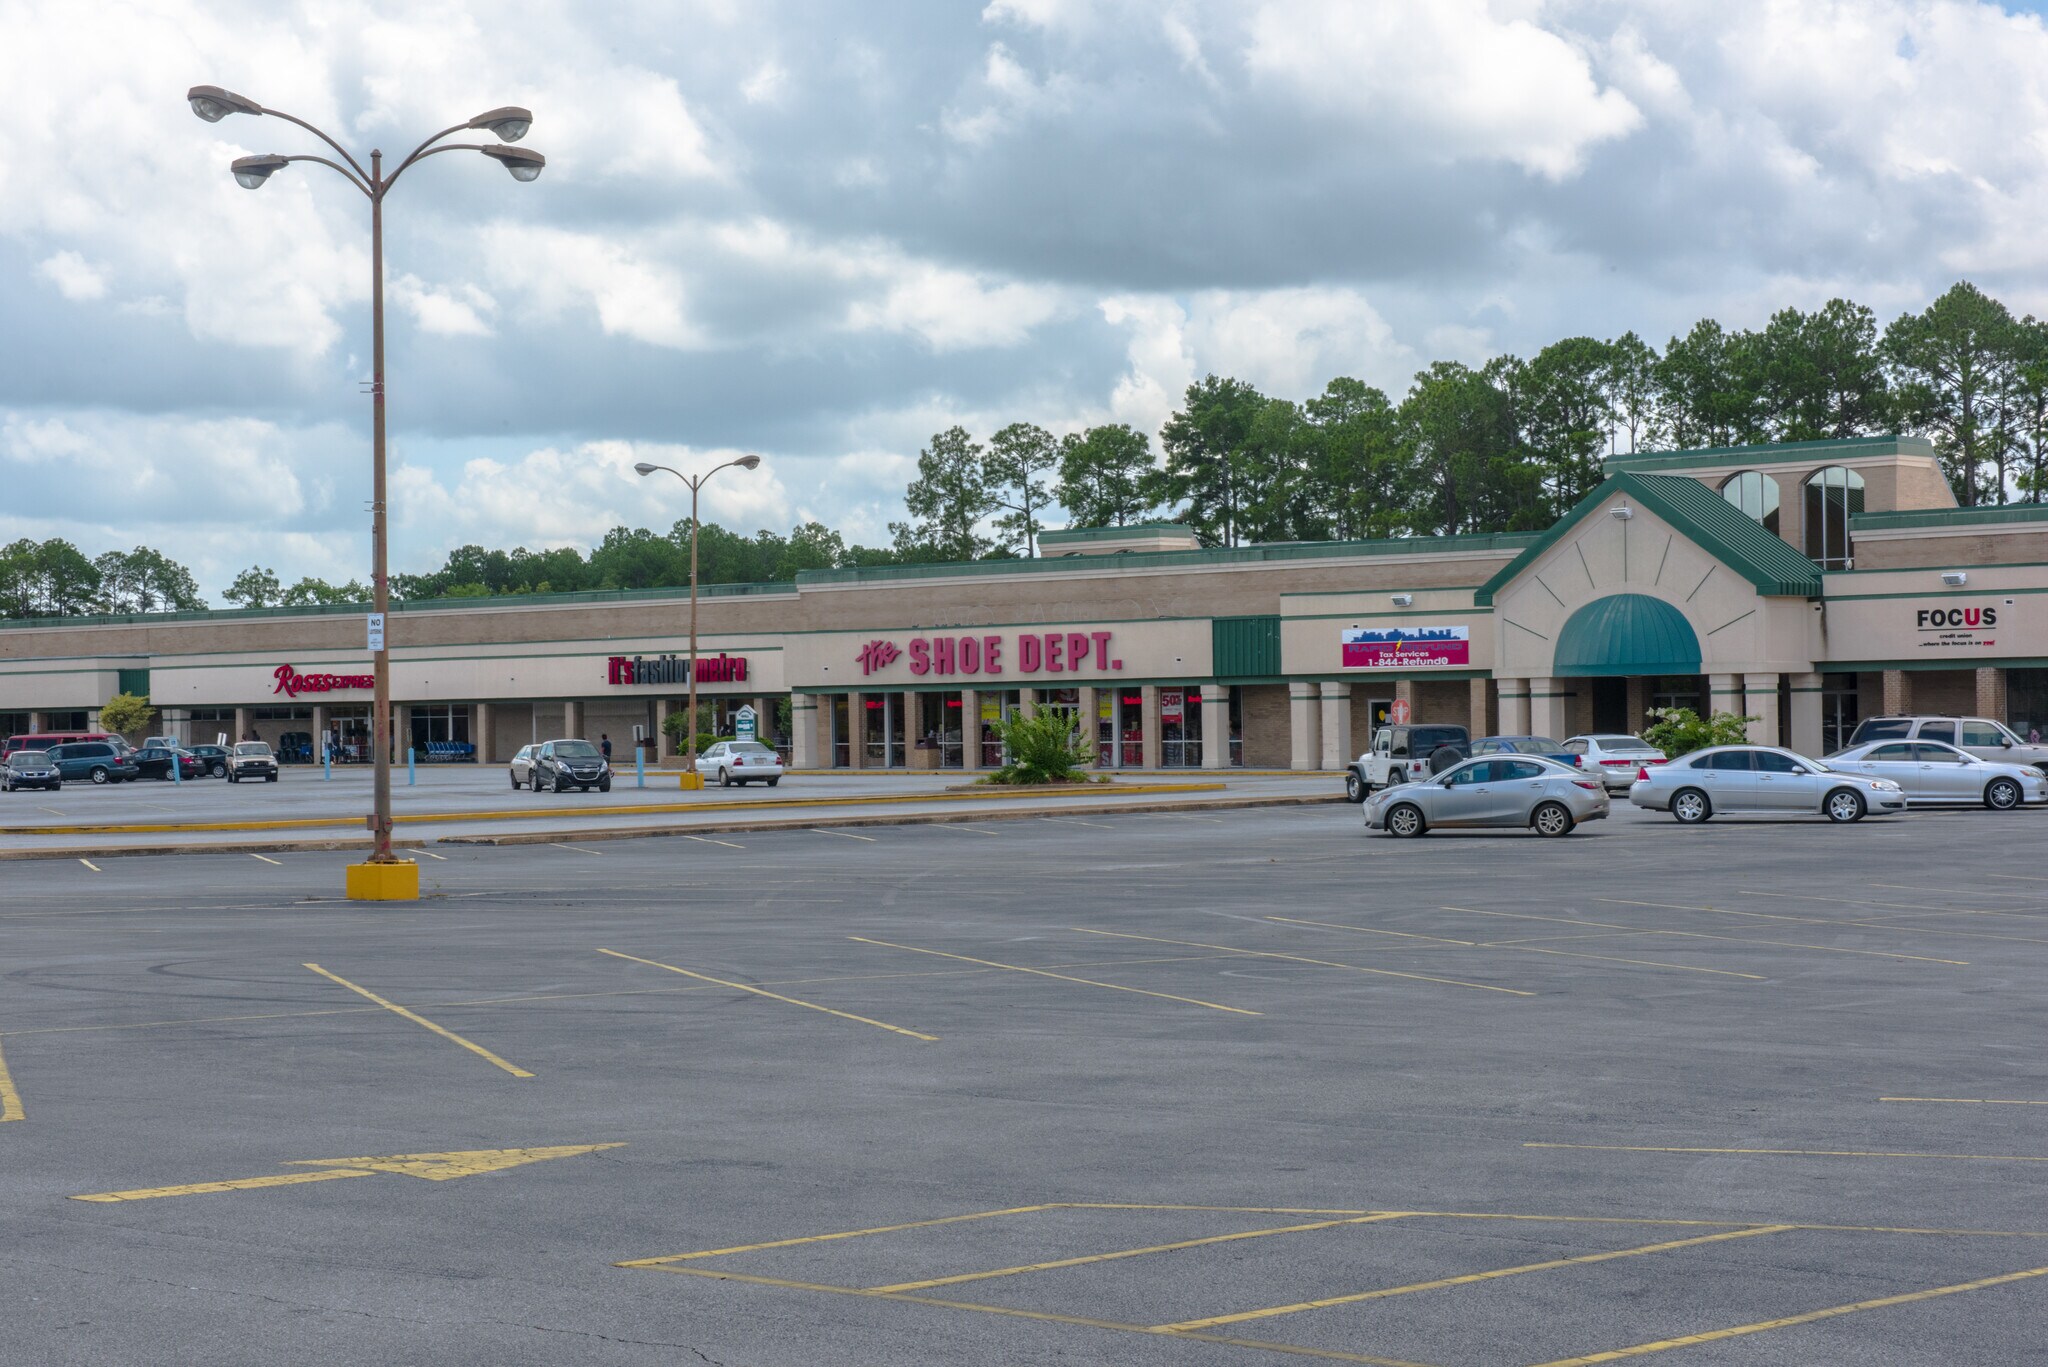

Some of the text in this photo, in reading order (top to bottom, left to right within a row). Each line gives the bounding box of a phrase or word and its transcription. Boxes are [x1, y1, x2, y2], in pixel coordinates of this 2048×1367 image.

[1917, 607, 1997, 627] FOCUS
[856, 632, 1122, 675] the SHOE DEPT.
